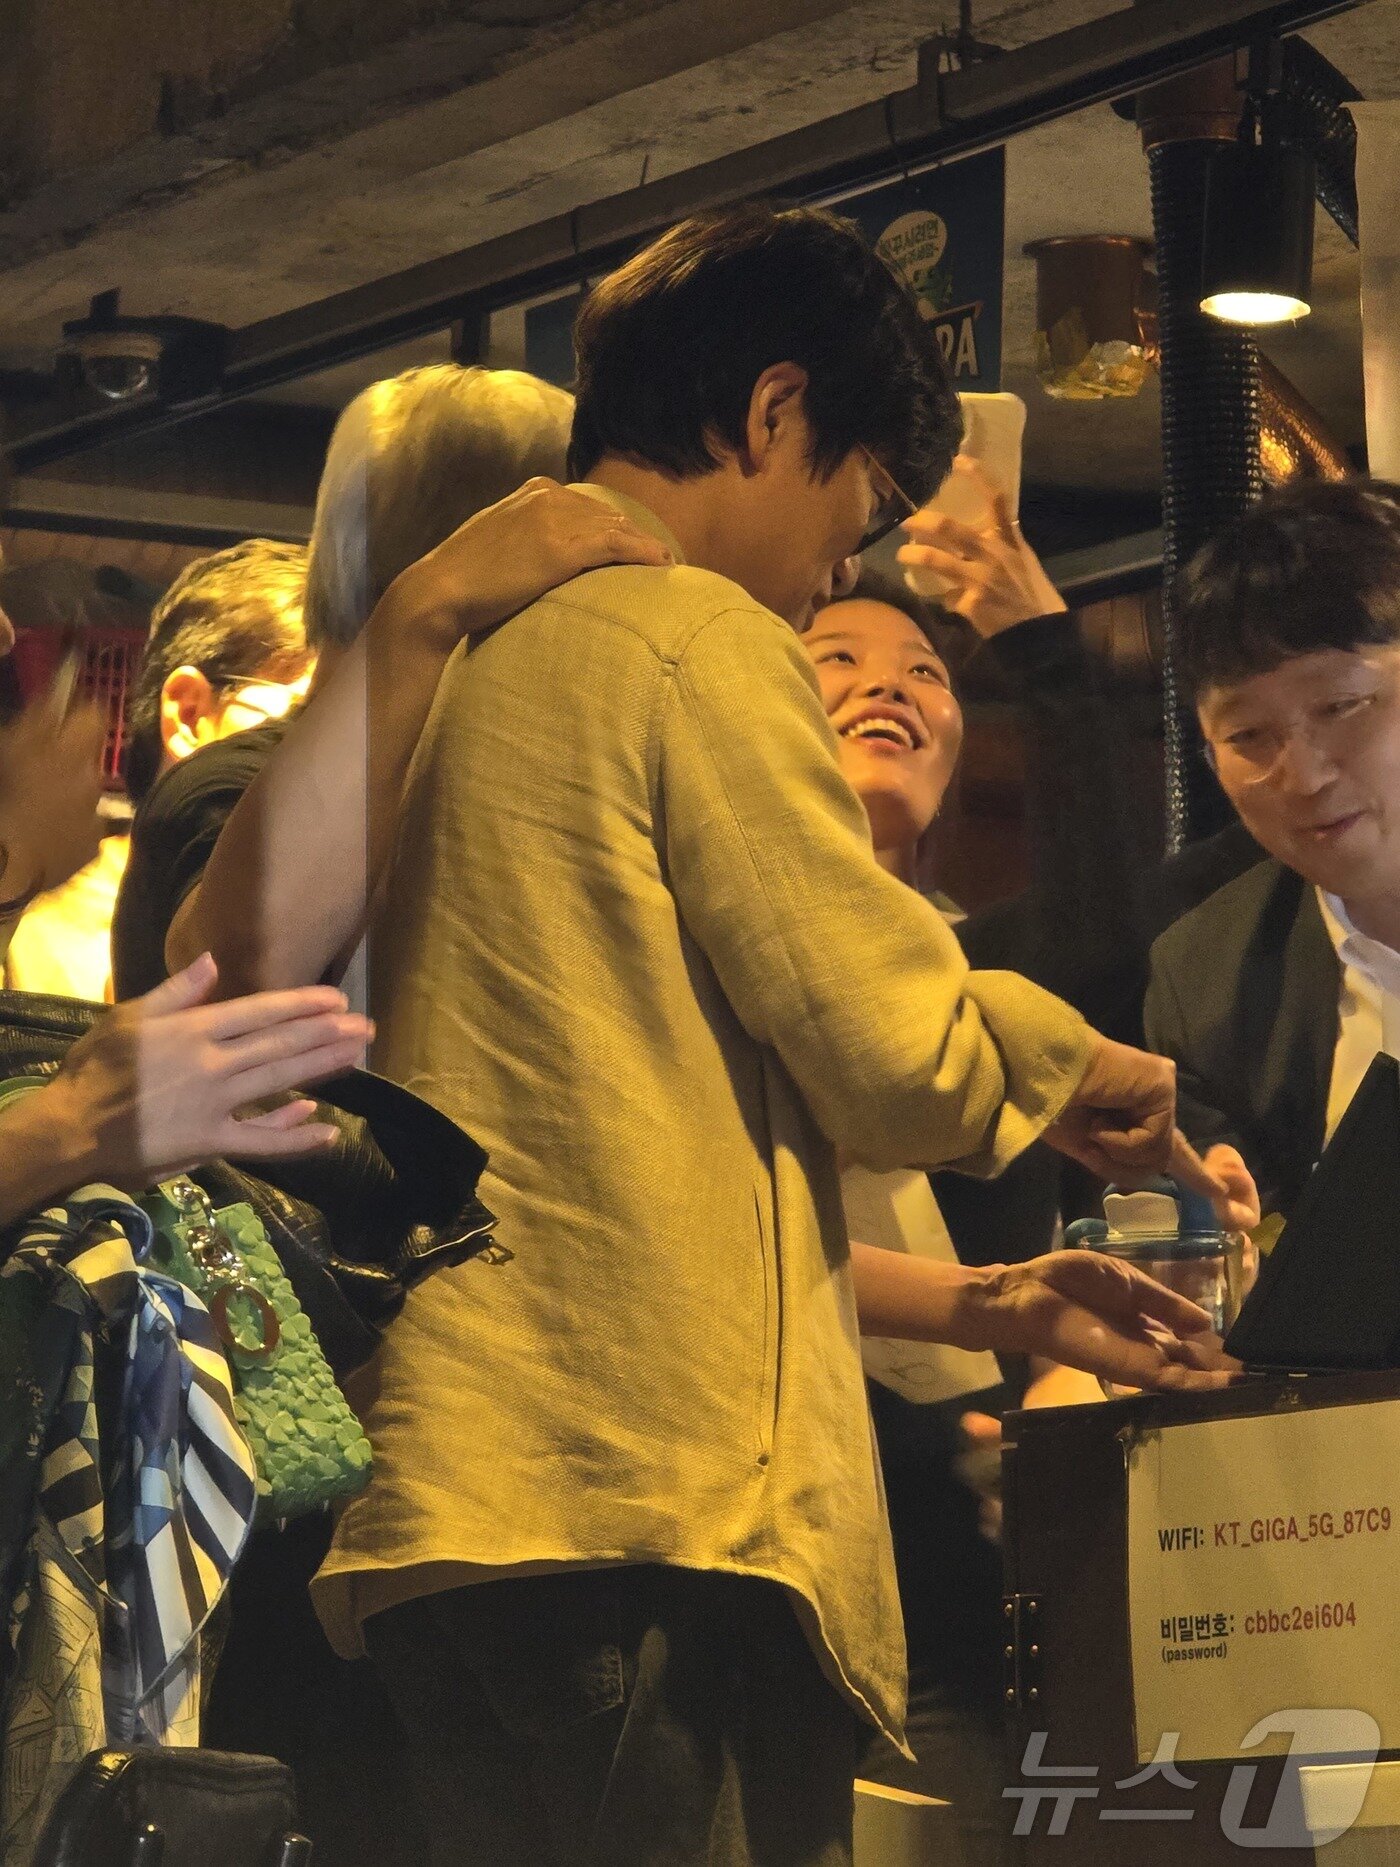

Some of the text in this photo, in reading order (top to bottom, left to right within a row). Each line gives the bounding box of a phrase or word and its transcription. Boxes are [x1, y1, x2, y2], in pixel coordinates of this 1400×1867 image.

[1158, 1506, 1391, 1551] WIFI: KT_GIGA_5G_87C9
[1160, 1601, 1357, 1643] 비밀번호: cbbc2ei604
[1161, 1642, 1228, 1663] (password)
